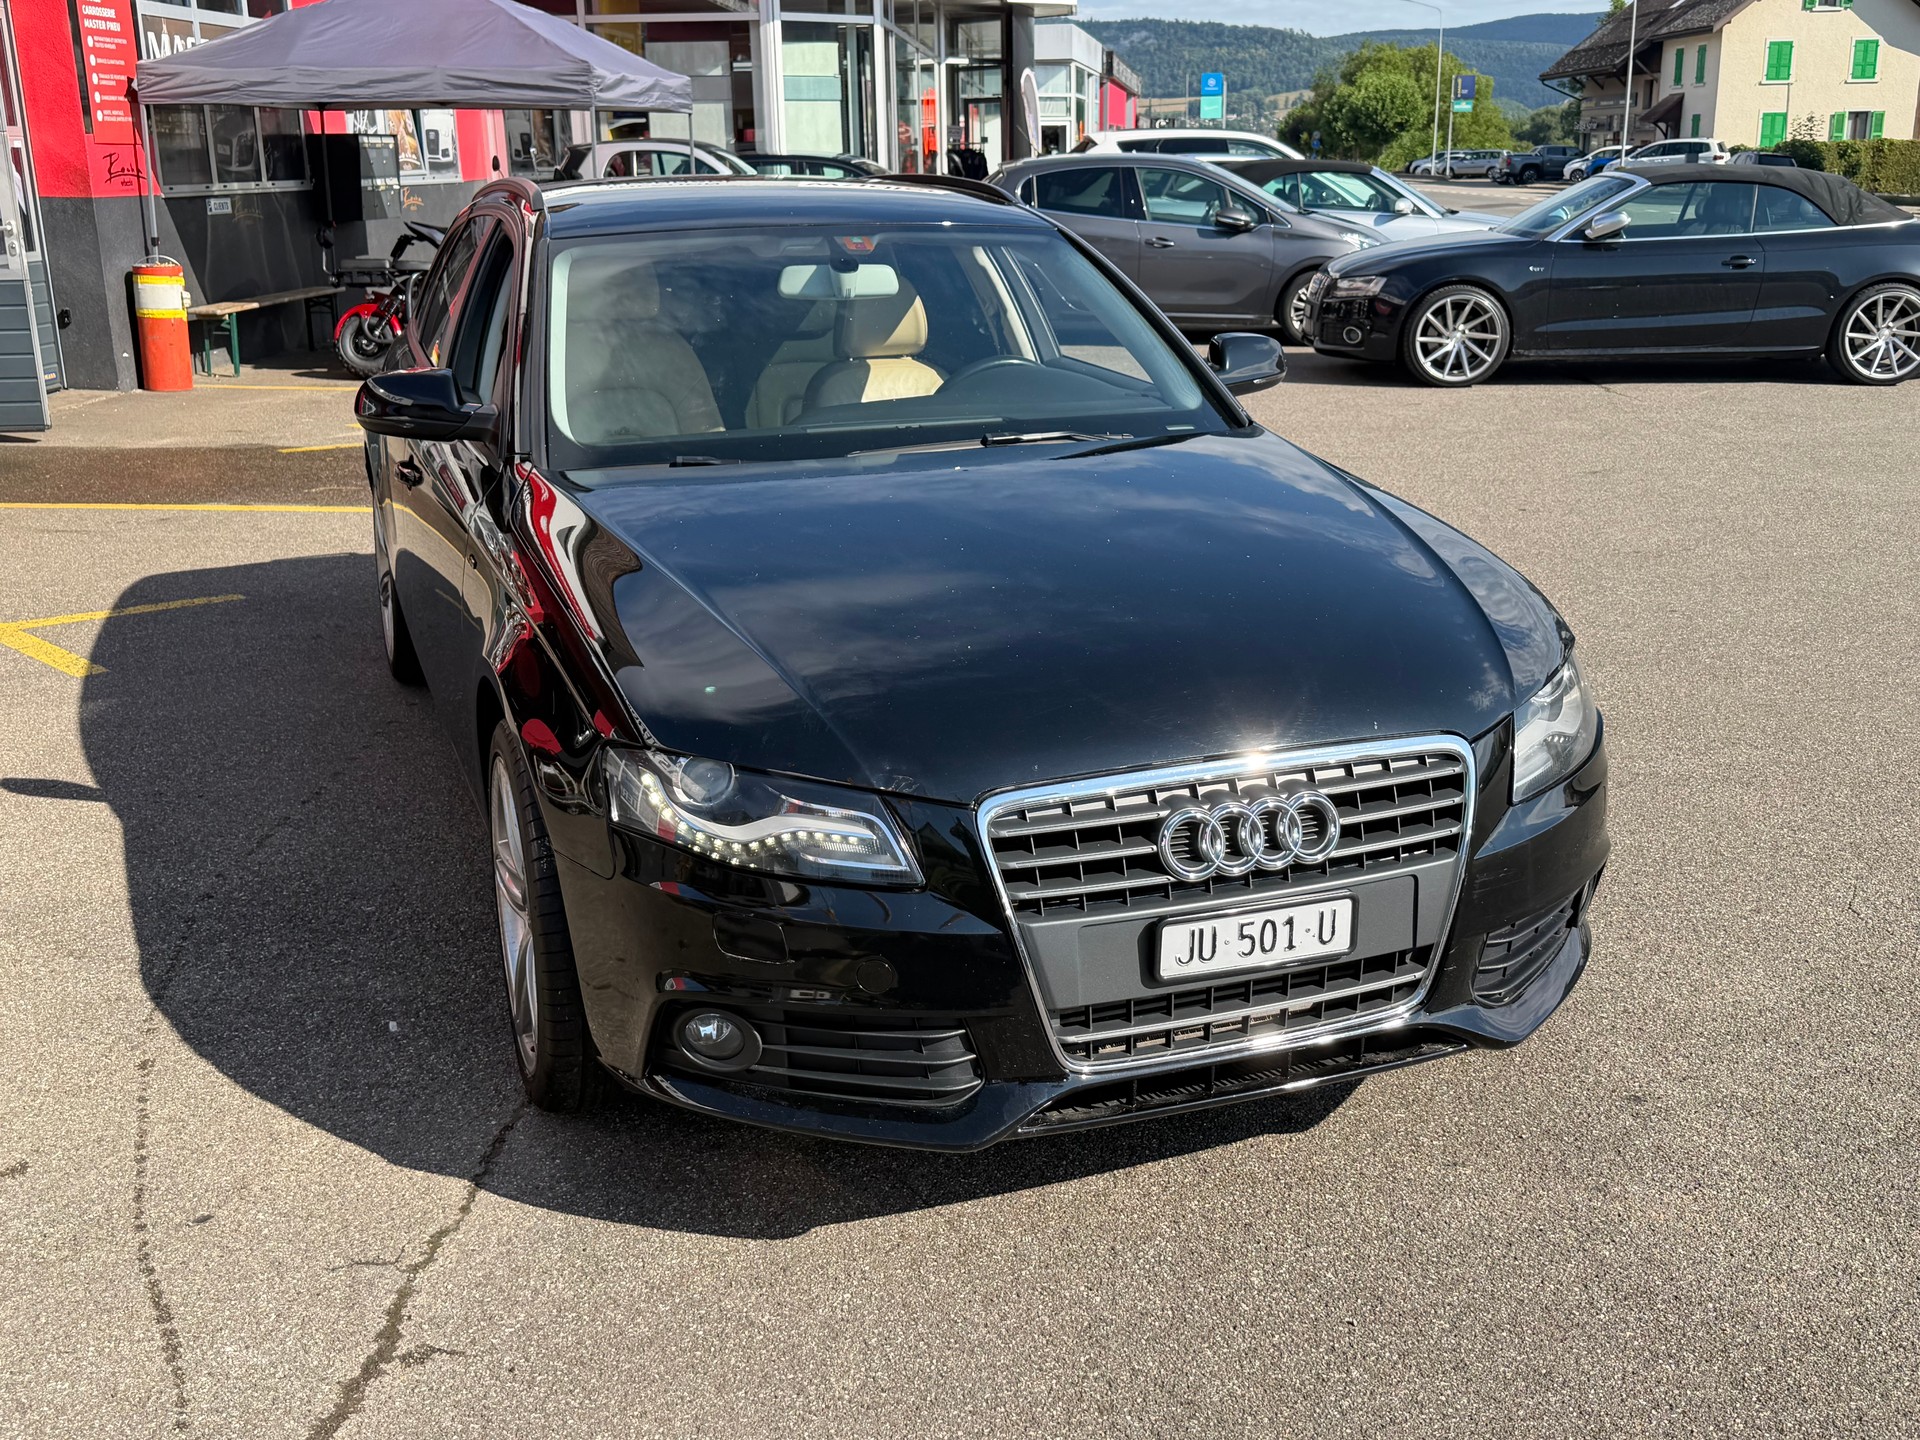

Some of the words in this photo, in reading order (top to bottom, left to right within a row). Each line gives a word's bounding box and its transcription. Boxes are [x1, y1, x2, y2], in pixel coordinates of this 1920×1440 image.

[82, 5, 116, 18] CARROSSERIE
[84, 18, 106, 30] MASTER
[107, 21, 121, 32] PNEU
[1175, 925, 1217, 967] JU
[1237, 913, 1297, 958] 501
[1318, 907, 1337, 945] U
